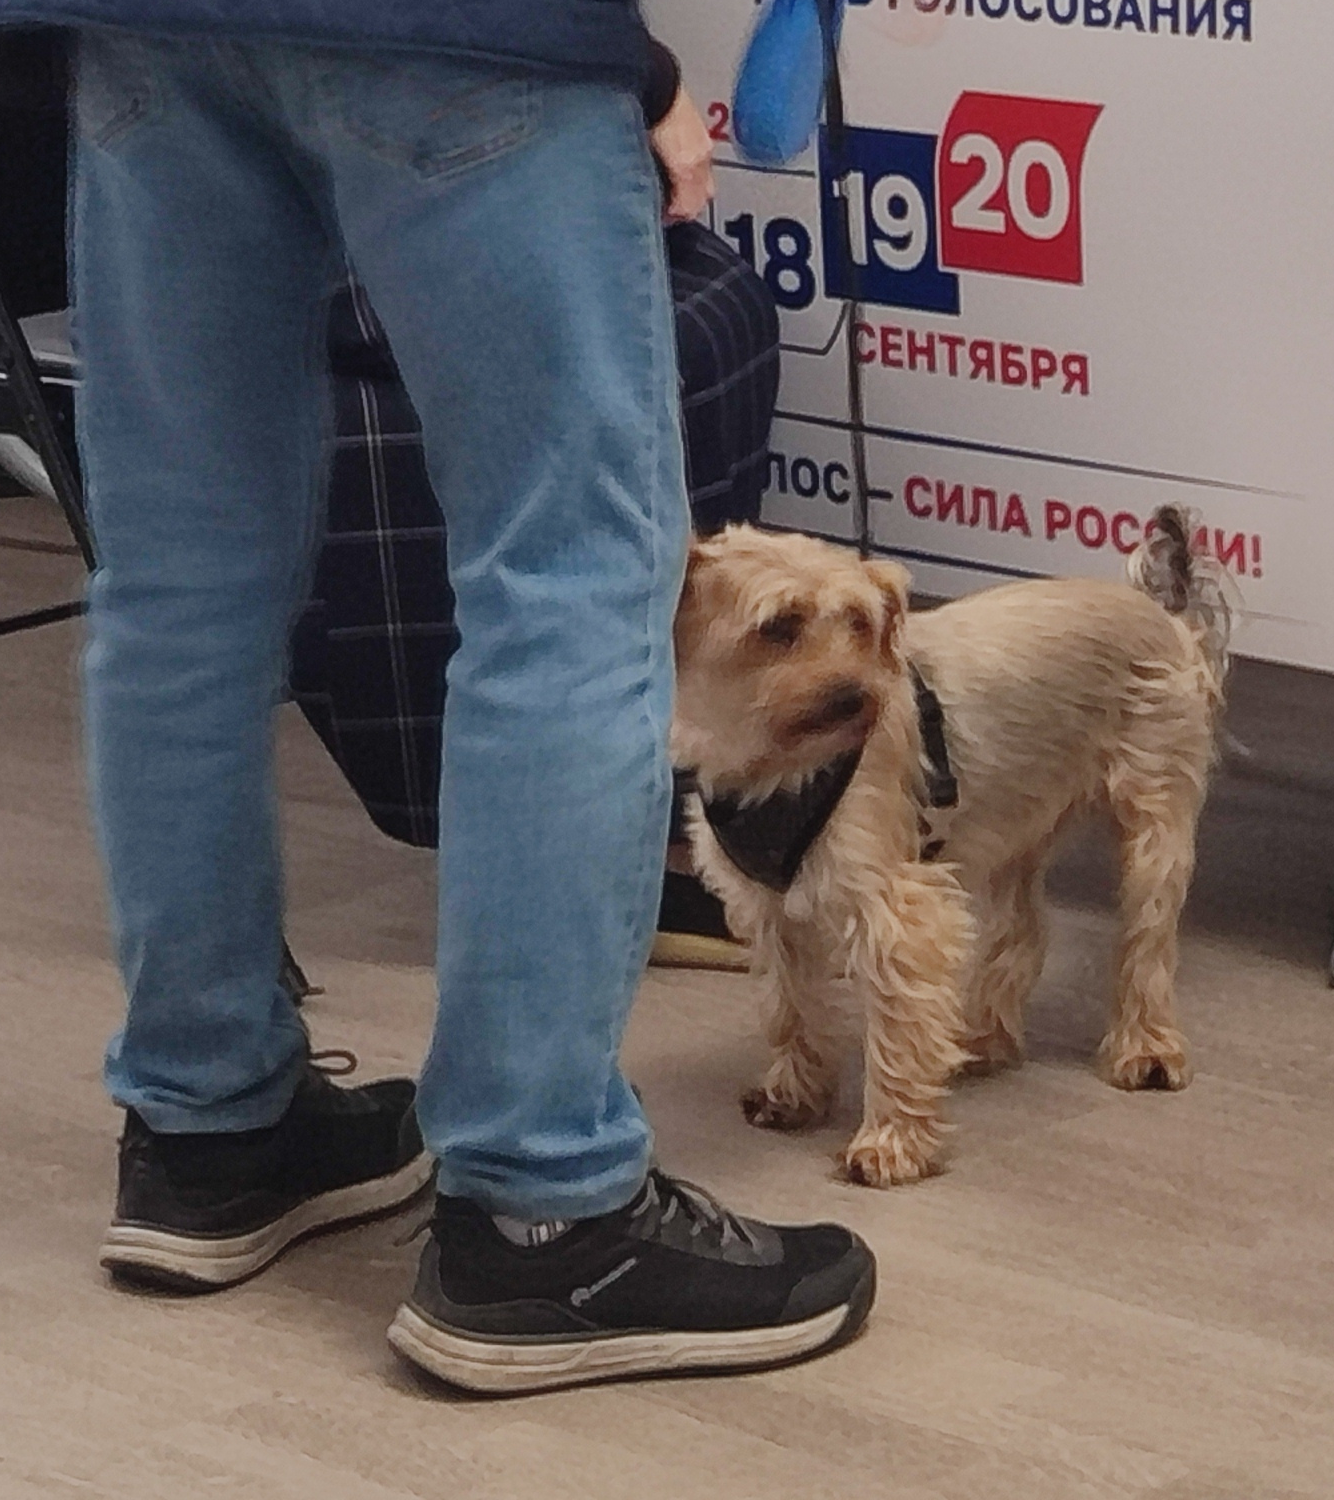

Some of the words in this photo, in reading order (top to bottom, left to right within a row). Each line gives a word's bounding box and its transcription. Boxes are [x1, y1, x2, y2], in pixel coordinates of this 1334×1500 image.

[725, 212, 816, 311] 18
[833, 169, 928, 272] 19
[949, 131, 1071, 241] 20
[851, 321, 1090, 397] СЕНТЯБРЯ
[766, 451, 851, 505] ЛОС
[903, 475, 1031, 538] СИЛА
